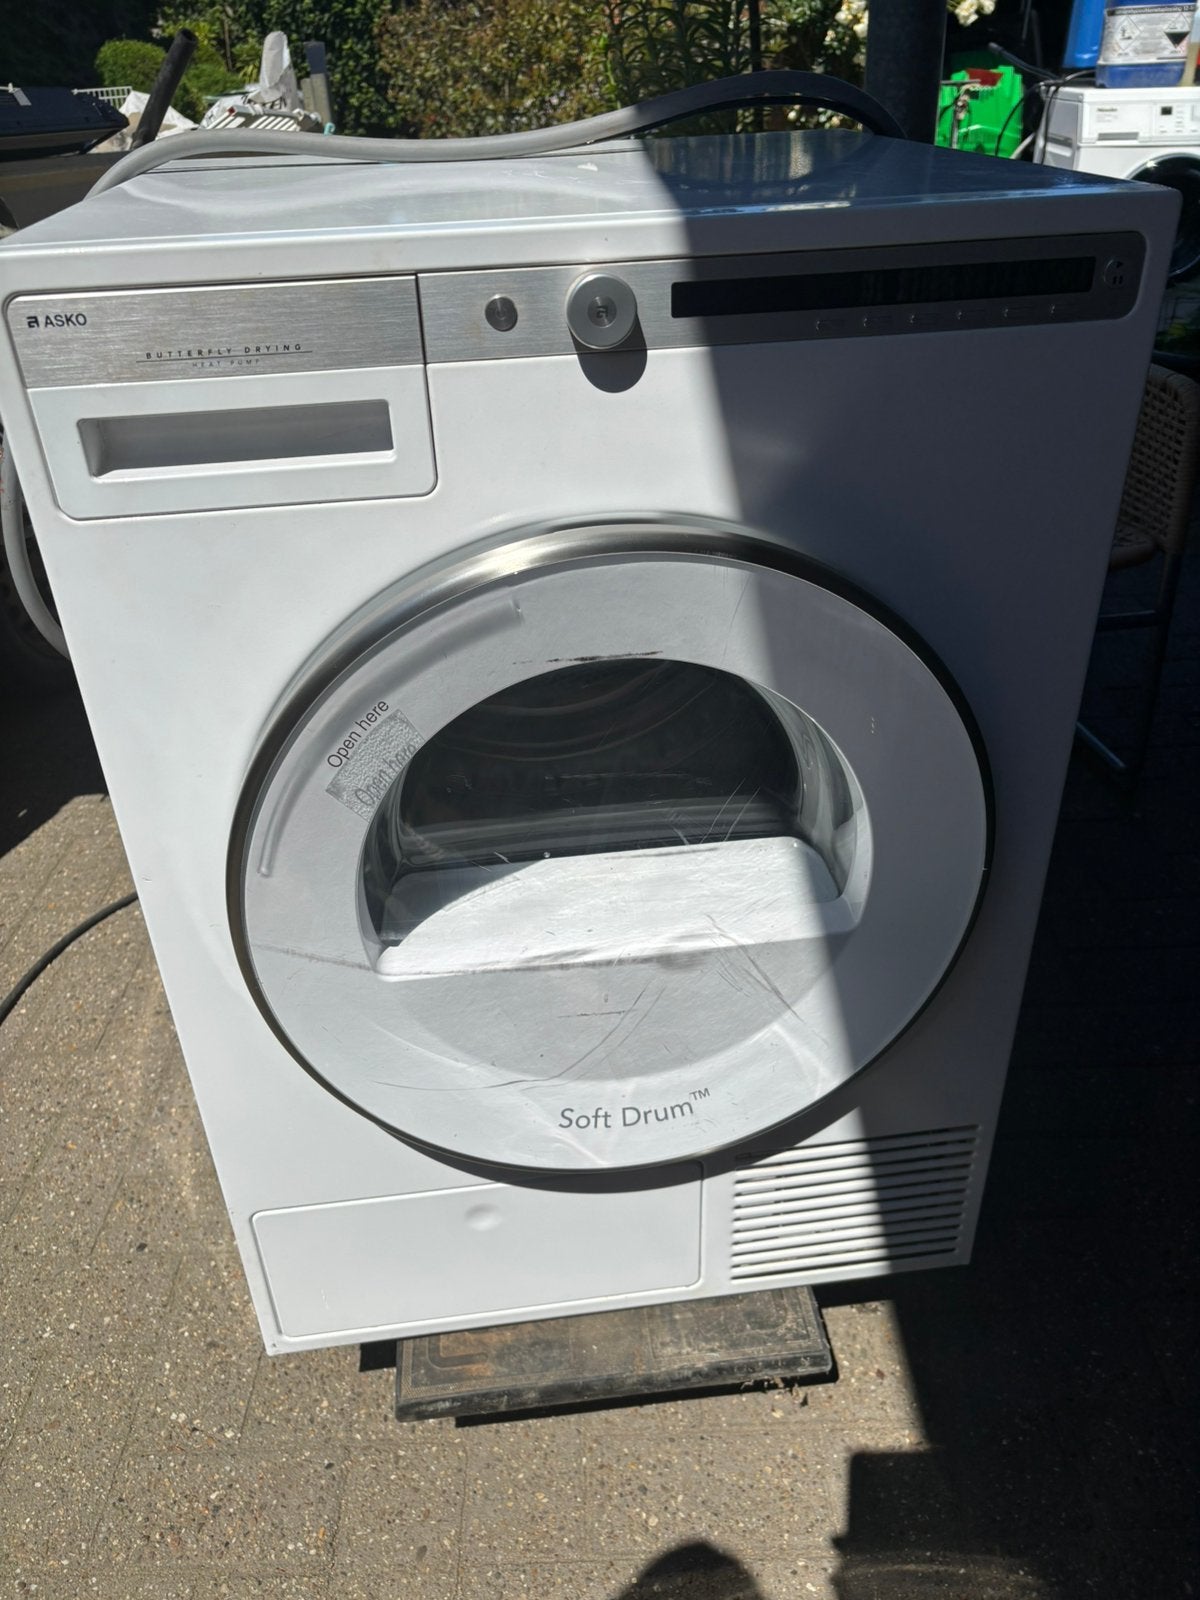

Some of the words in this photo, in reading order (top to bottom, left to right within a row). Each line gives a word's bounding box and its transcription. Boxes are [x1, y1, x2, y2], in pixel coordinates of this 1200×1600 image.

[45, 313, 87, 328] ASKO
[146, 348, 232, 359] BUTTERFLY
[244, 343, 302, 353] DRYING
[327, 731, 362, 768] Open
[355, 701, 389, 731] here
[558, 1107, 612, 1129] Soft
